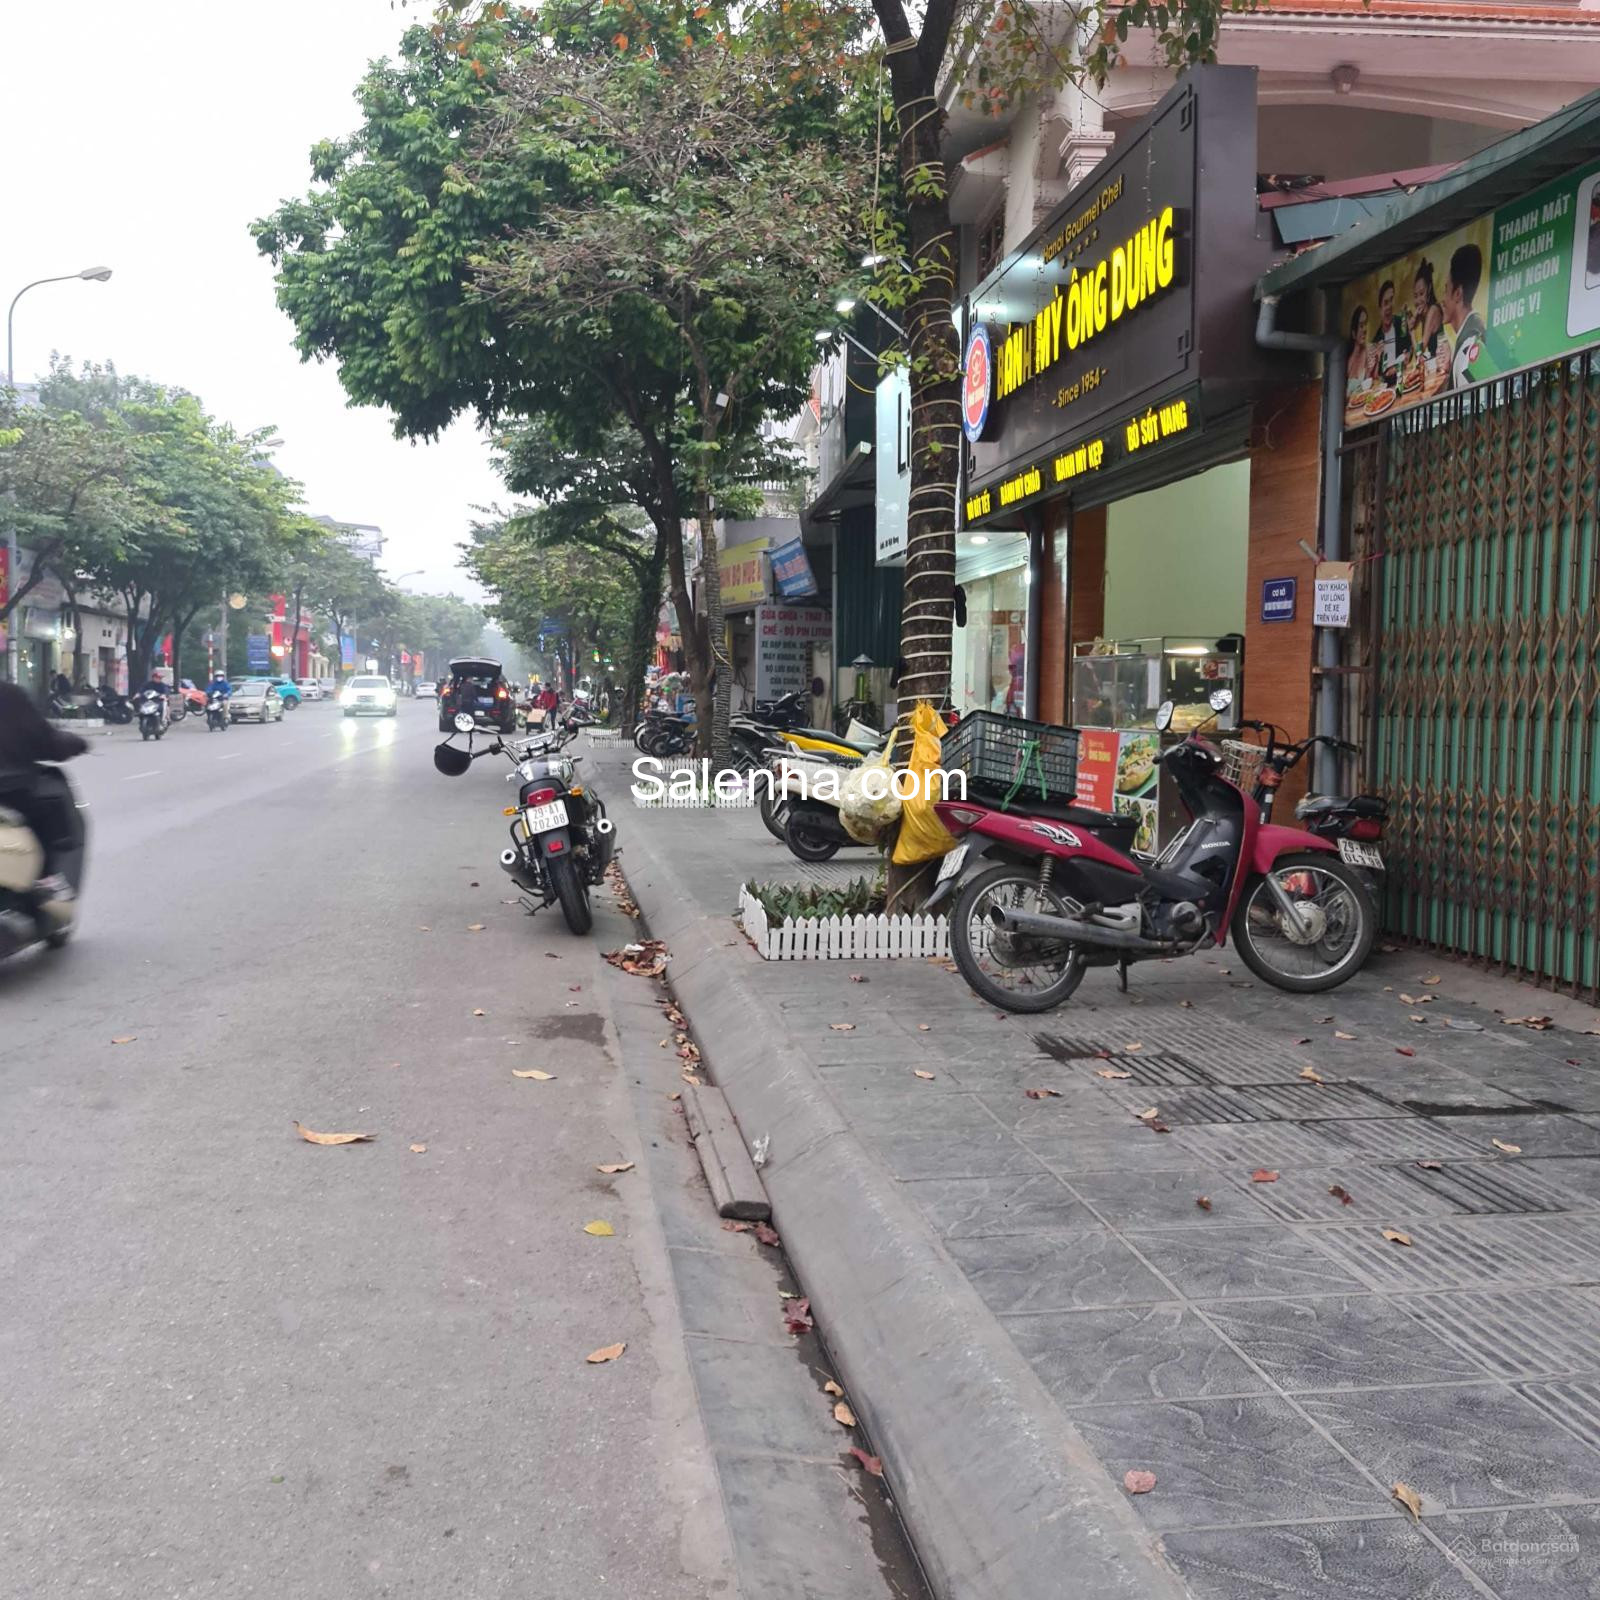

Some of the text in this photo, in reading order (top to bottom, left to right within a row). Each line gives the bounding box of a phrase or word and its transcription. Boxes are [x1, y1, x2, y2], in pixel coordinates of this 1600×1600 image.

[1043, 174, 1123, 263] Hanoi Gourmet Chef
[1499, 193, 1571, 244] THANH MÁT
[1511, 229, 1555, 266] CHANH
[1524, 255, 1560, 287] NGON
[997, 322, 1032, 401] BÁNH
[1035, 284, 1063, 375] MỲ
[1066, 267, 1108, 350] ÔNG
[1111, 206, 1173, 322] DUNG
[1058, 387, 1080, 408] Since
[1081, 366, 1100, 395] 1954
[1140, 407, 1159, 445] SỐT
[1159, 400, 1188, 437] VANG
[1087, 439, 1104, 471] KẸP
[1201, 840, 1231, 850] HONDA
